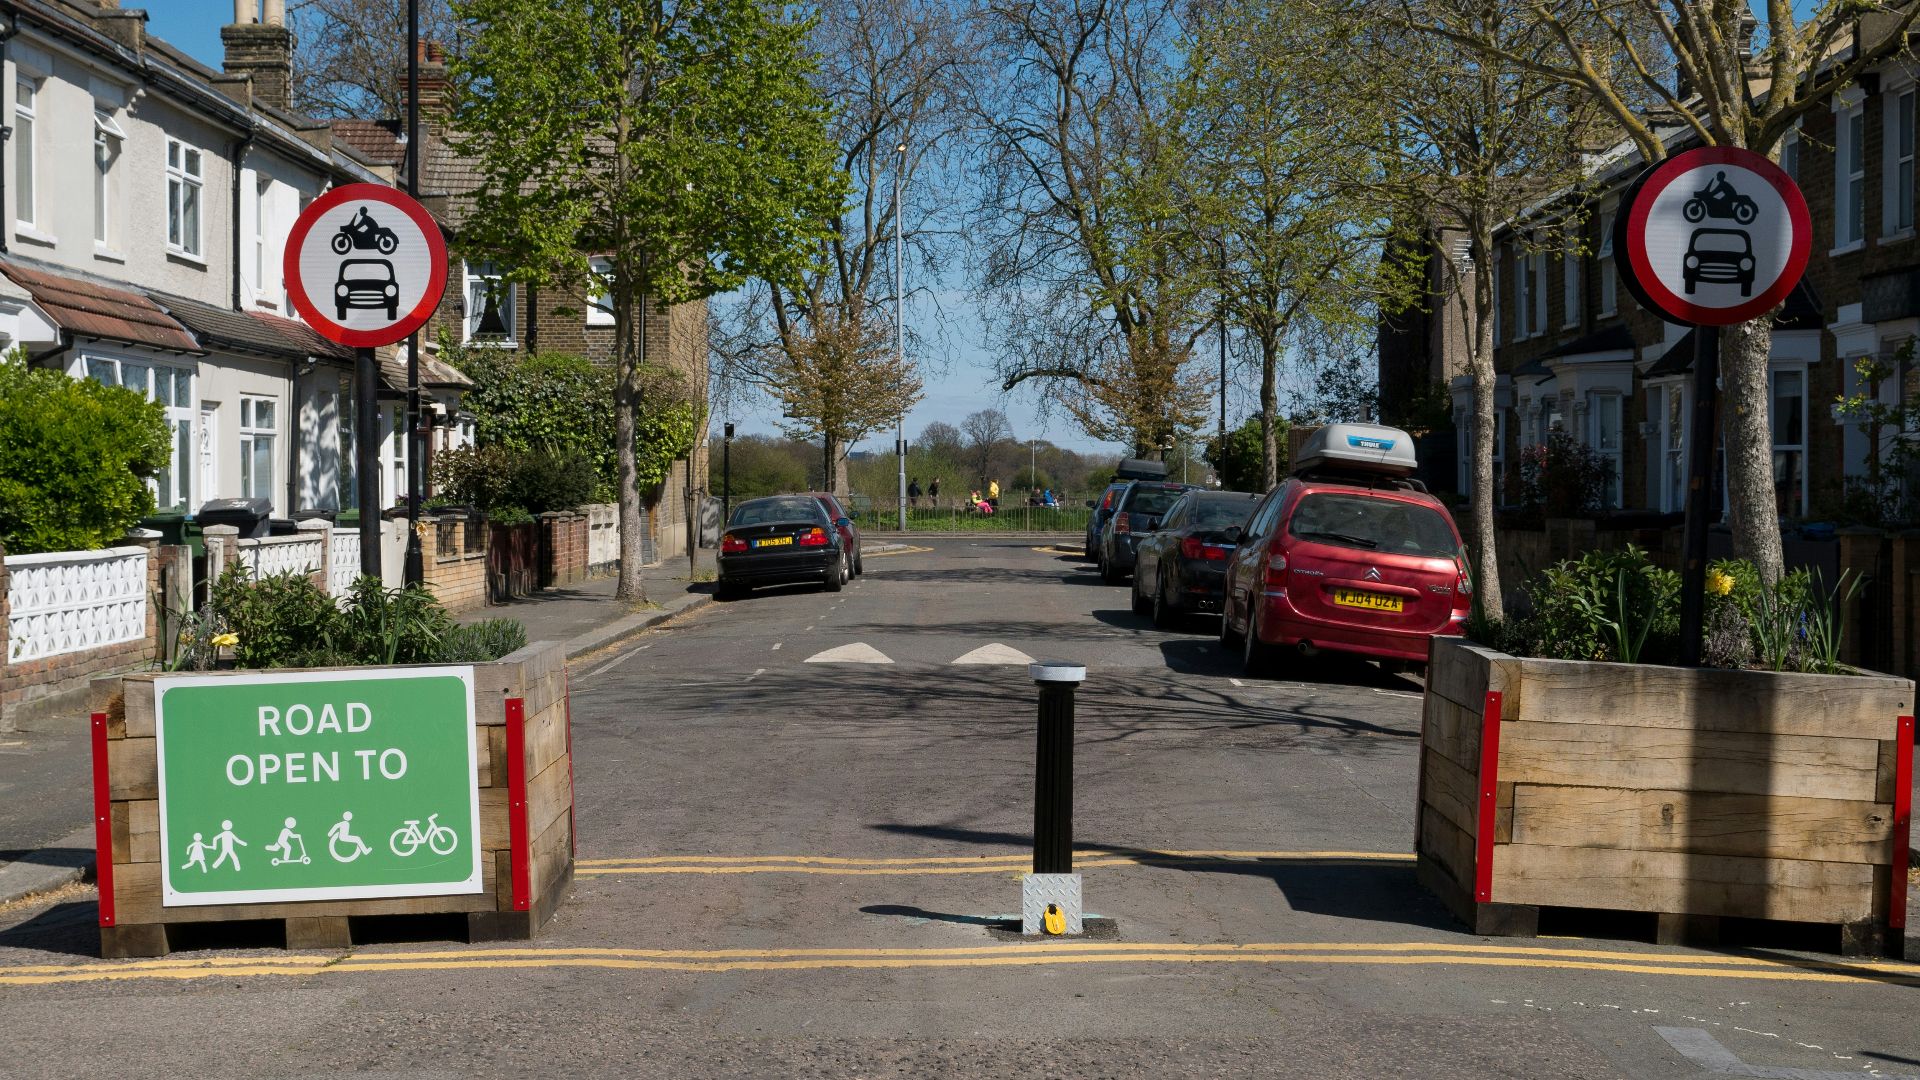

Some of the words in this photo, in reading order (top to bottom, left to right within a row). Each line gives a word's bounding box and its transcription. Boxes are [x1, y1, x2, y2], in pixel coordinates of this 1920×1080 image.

[1360, 441, 1380, 449] THULE
[1340, 591, 1371, 605] WJ04
[1375, 595, 1398, 608] UZA
[258, 702, 372, 736] ROAD
[226, 751, 340, 786] OPEN
[354, 748, 408, 780] TO
